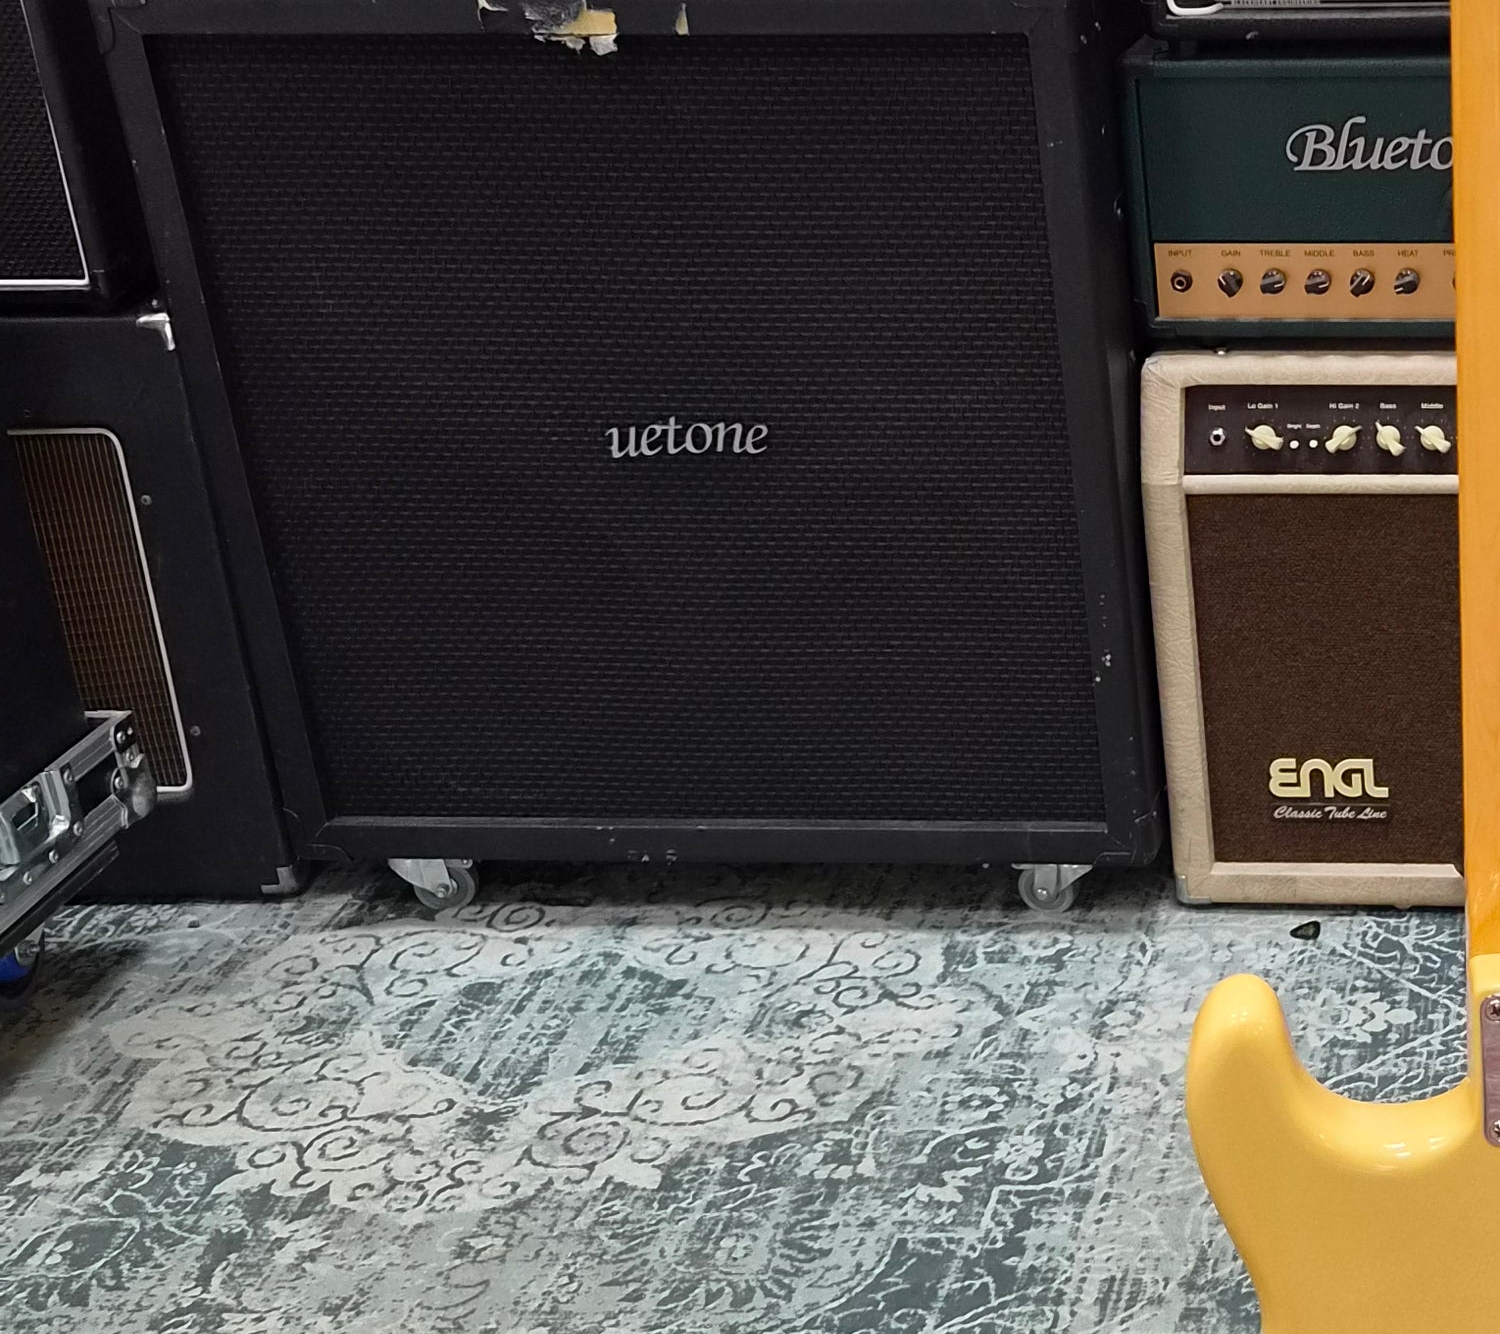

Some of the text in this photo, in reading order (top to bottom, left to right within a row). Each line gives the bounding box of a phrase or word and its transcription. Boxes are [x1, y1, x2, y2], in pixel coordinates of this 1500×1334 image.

[1285, 116, 1453, 171] Blueto
[604, 416, 769, 459] uetone
[1269, 758, 1389, 798] ENGL
[1273, 805, 1387, 819] Classic Tube Line
